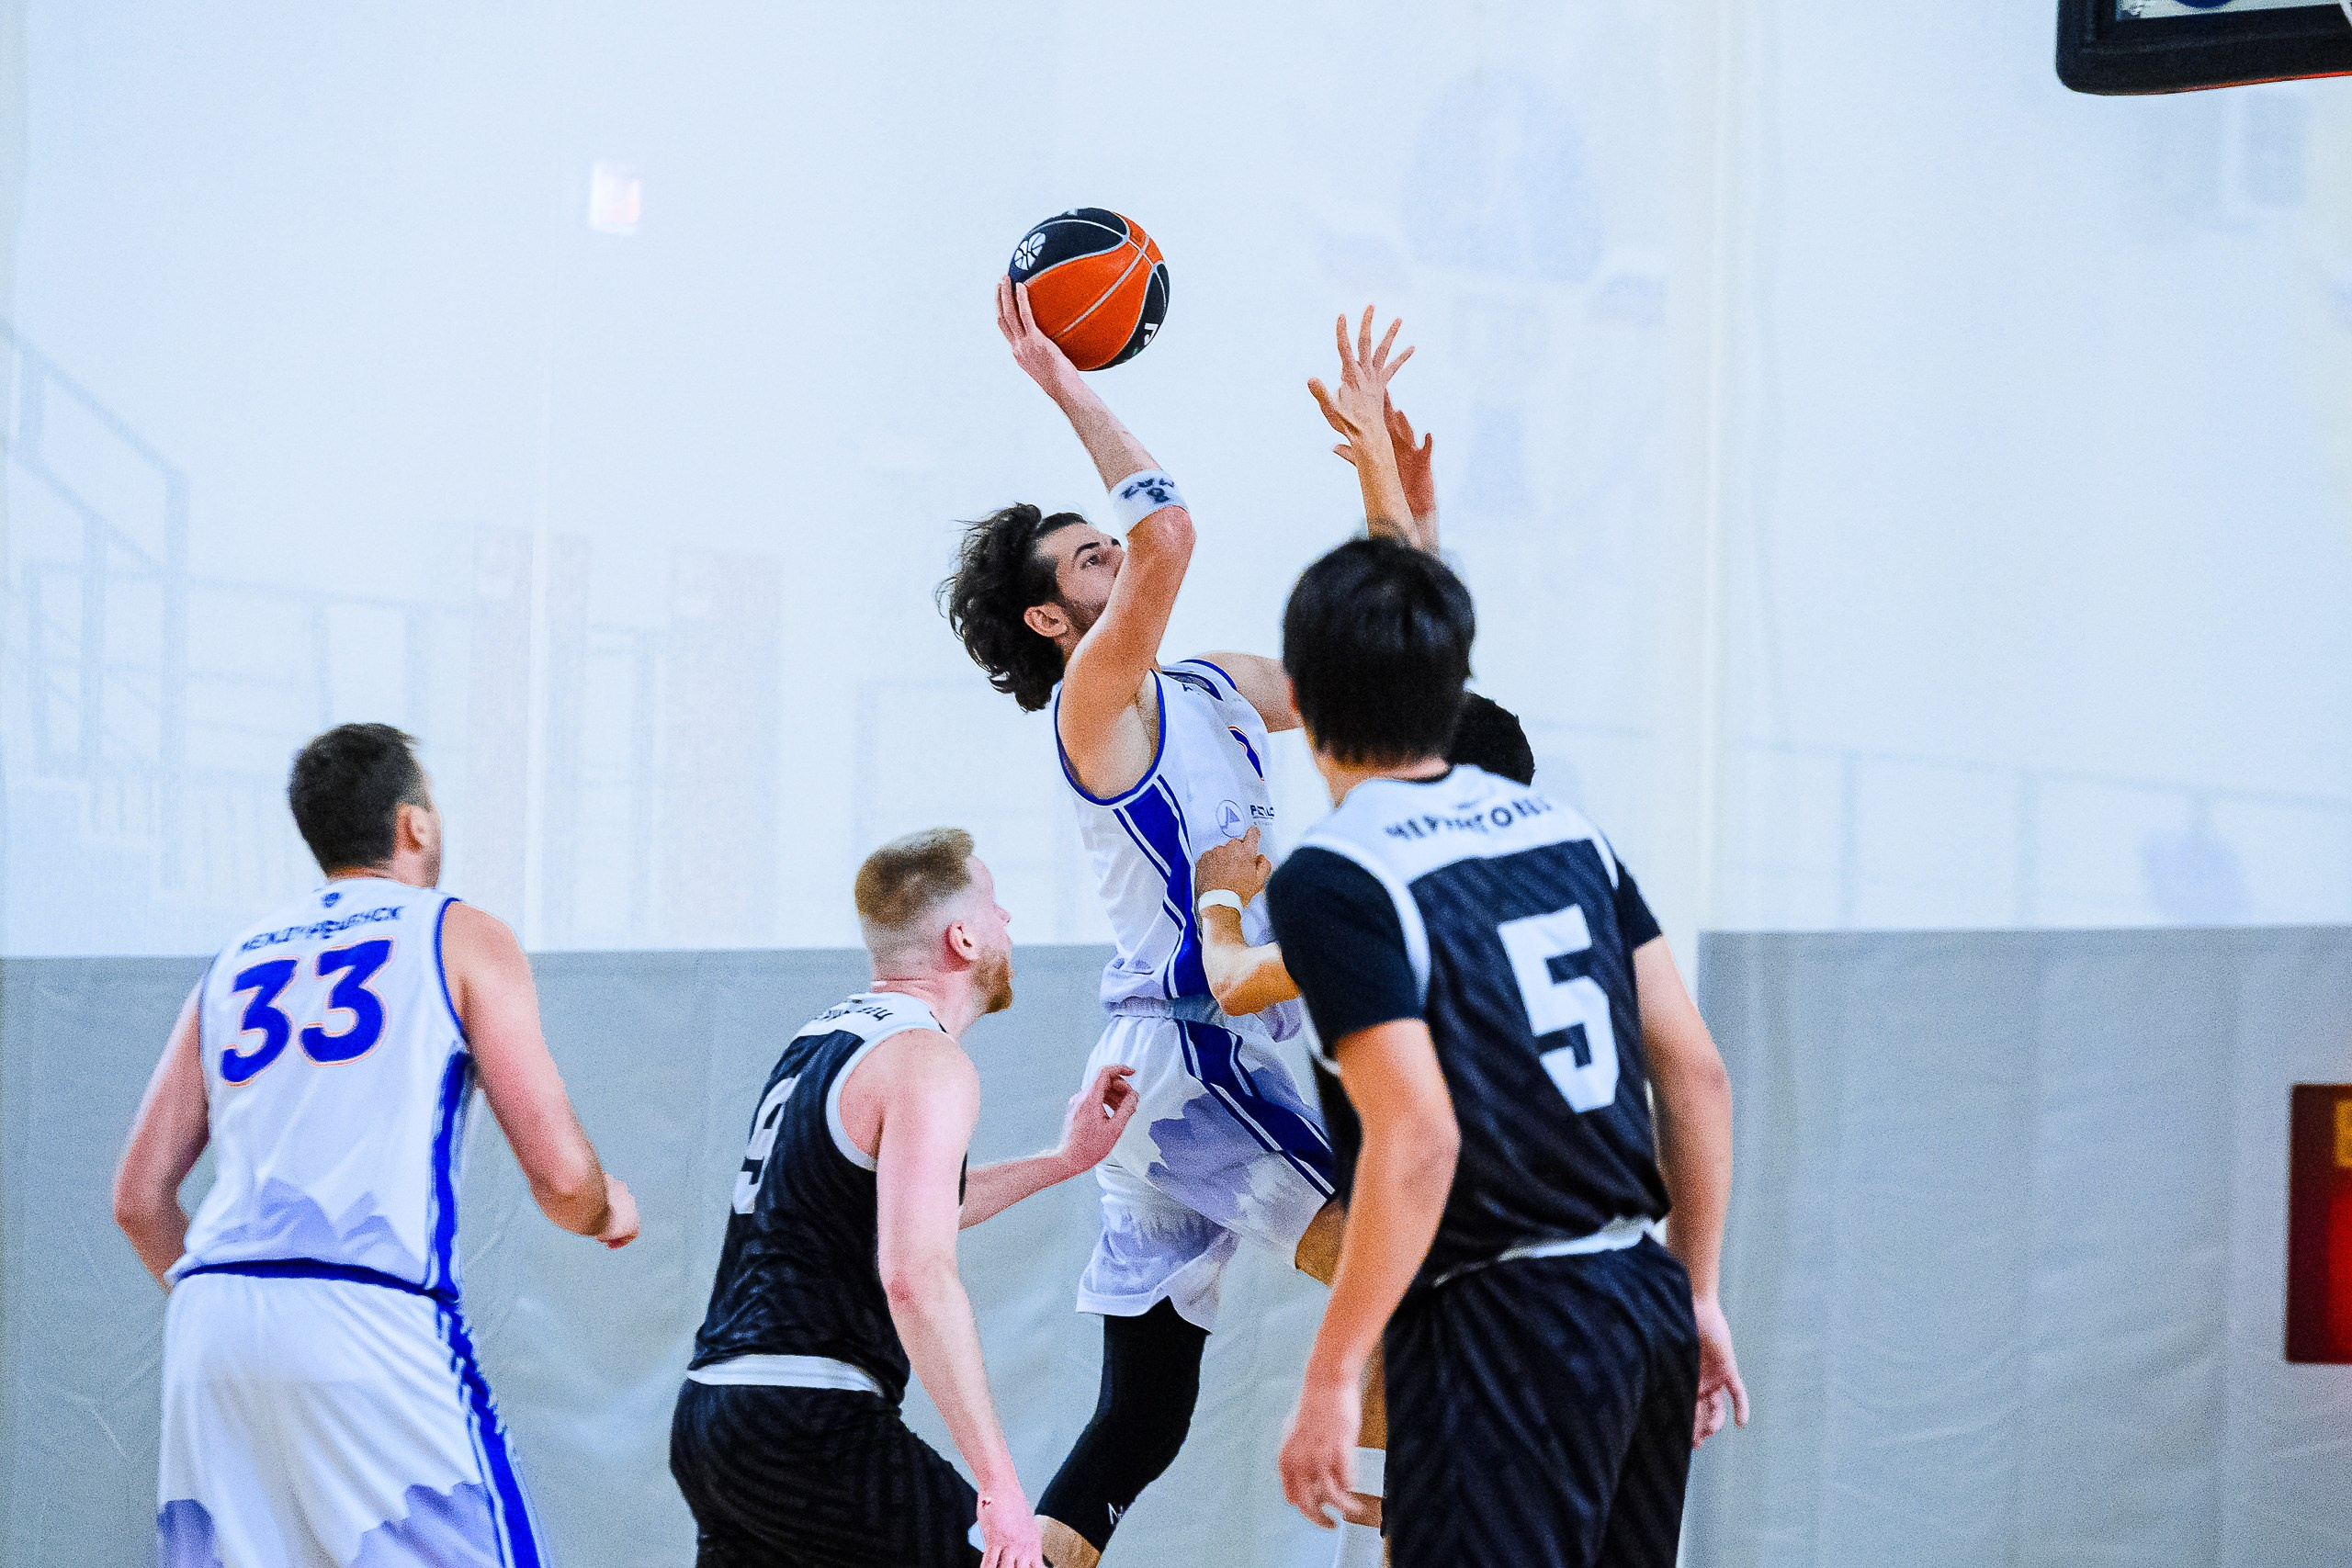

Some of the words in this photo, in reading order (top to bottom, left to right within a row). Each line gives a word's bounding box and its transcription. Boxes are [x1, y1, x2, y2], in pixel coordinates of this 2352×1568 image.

[219, 936, 396, 1088] 33
[1497, 903, 1620, 1114] 5
[732, 1074, 802, 1214] 9
